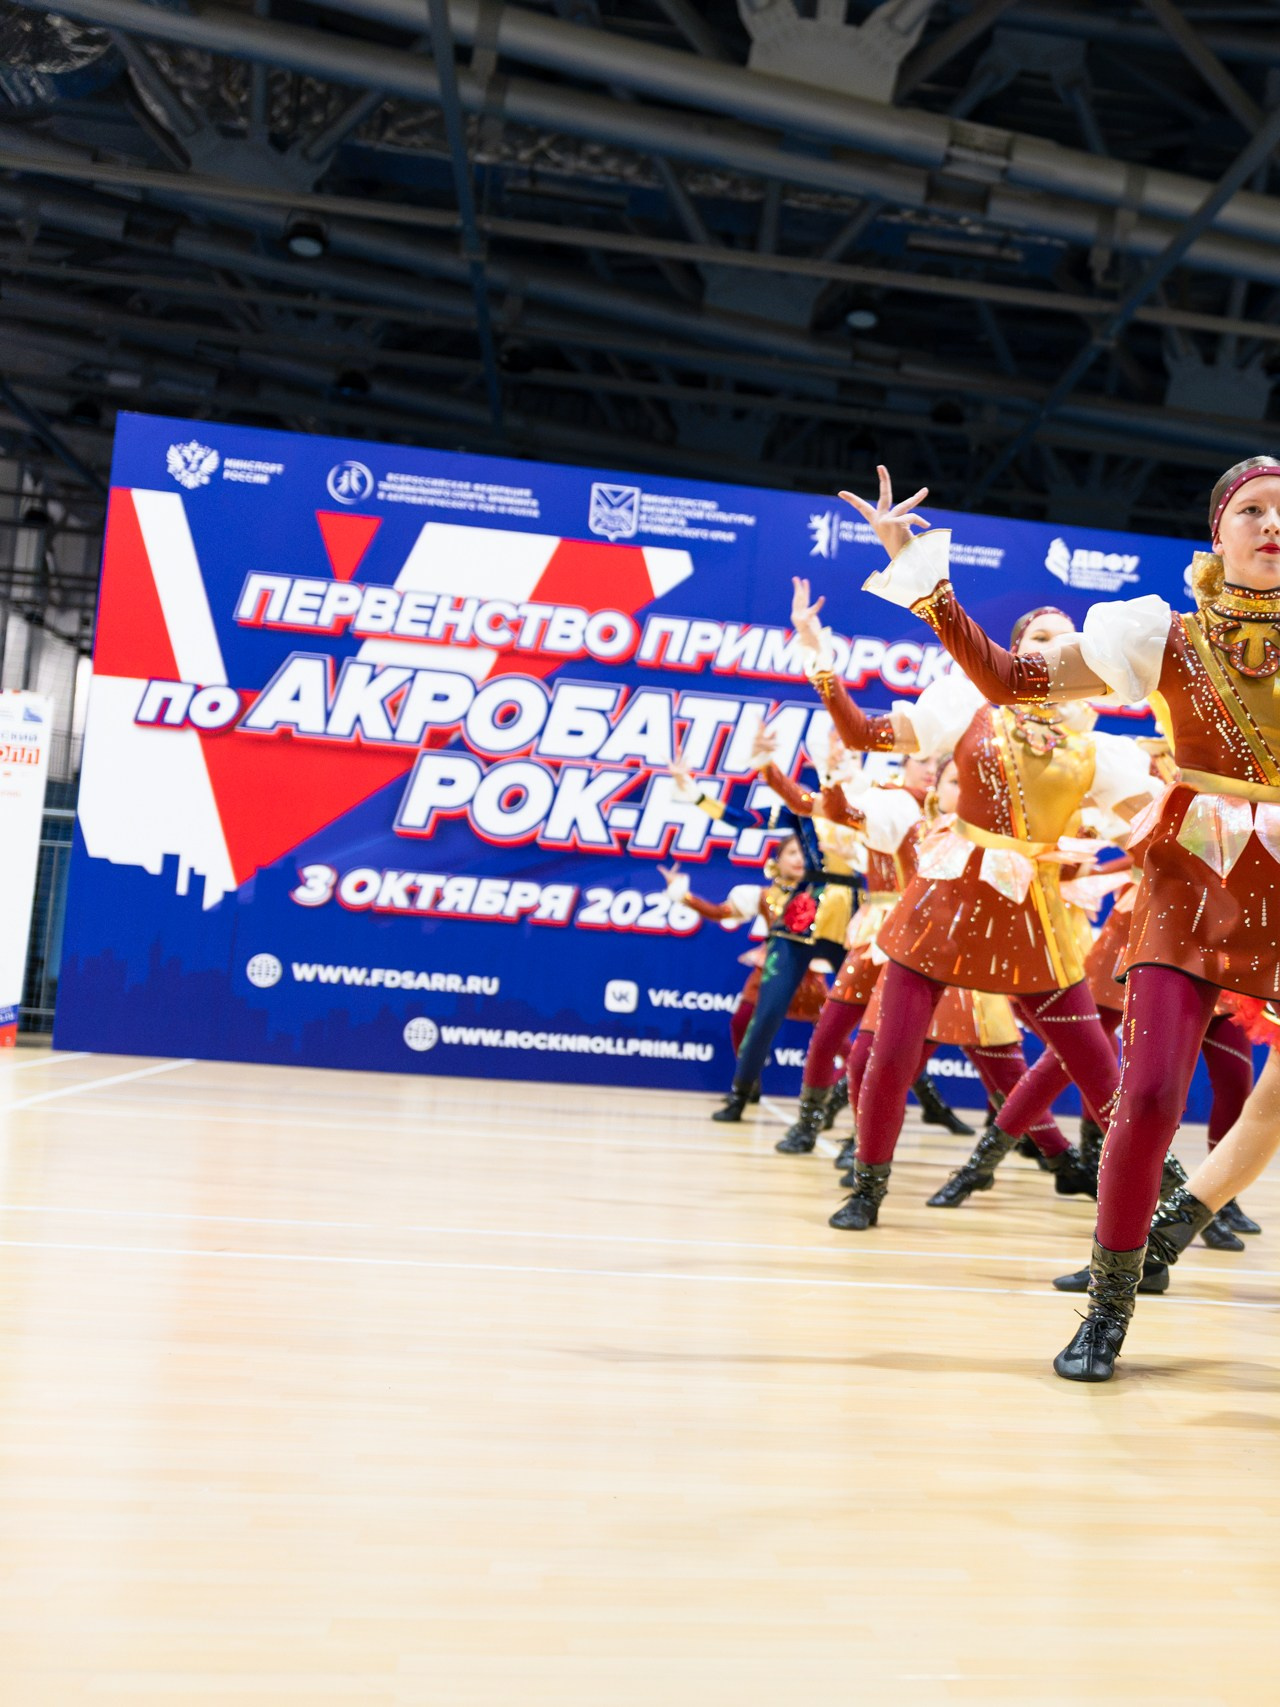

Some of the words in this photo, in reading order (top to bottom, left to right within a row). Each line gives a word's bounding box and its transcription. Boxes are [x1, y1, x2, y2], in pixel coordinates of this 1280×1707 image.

[222, 468, 270, 485] РОССИИ
[1070, 549, 1140, 574] ДВФУ
[235, 571, 638, 662] ПЕРВЕНСТВО
[636, 614, 964, 691] ПРИМРСК
[290, 864, 336, 907] 3
[337, 867, 578, 926] ОКТЯБРЯ
[291, 962, 500, 996] WWW.FDSARR.RU
[440, 1026, 713, 1062] WWW.ROCKNROLLPRIM.RU
